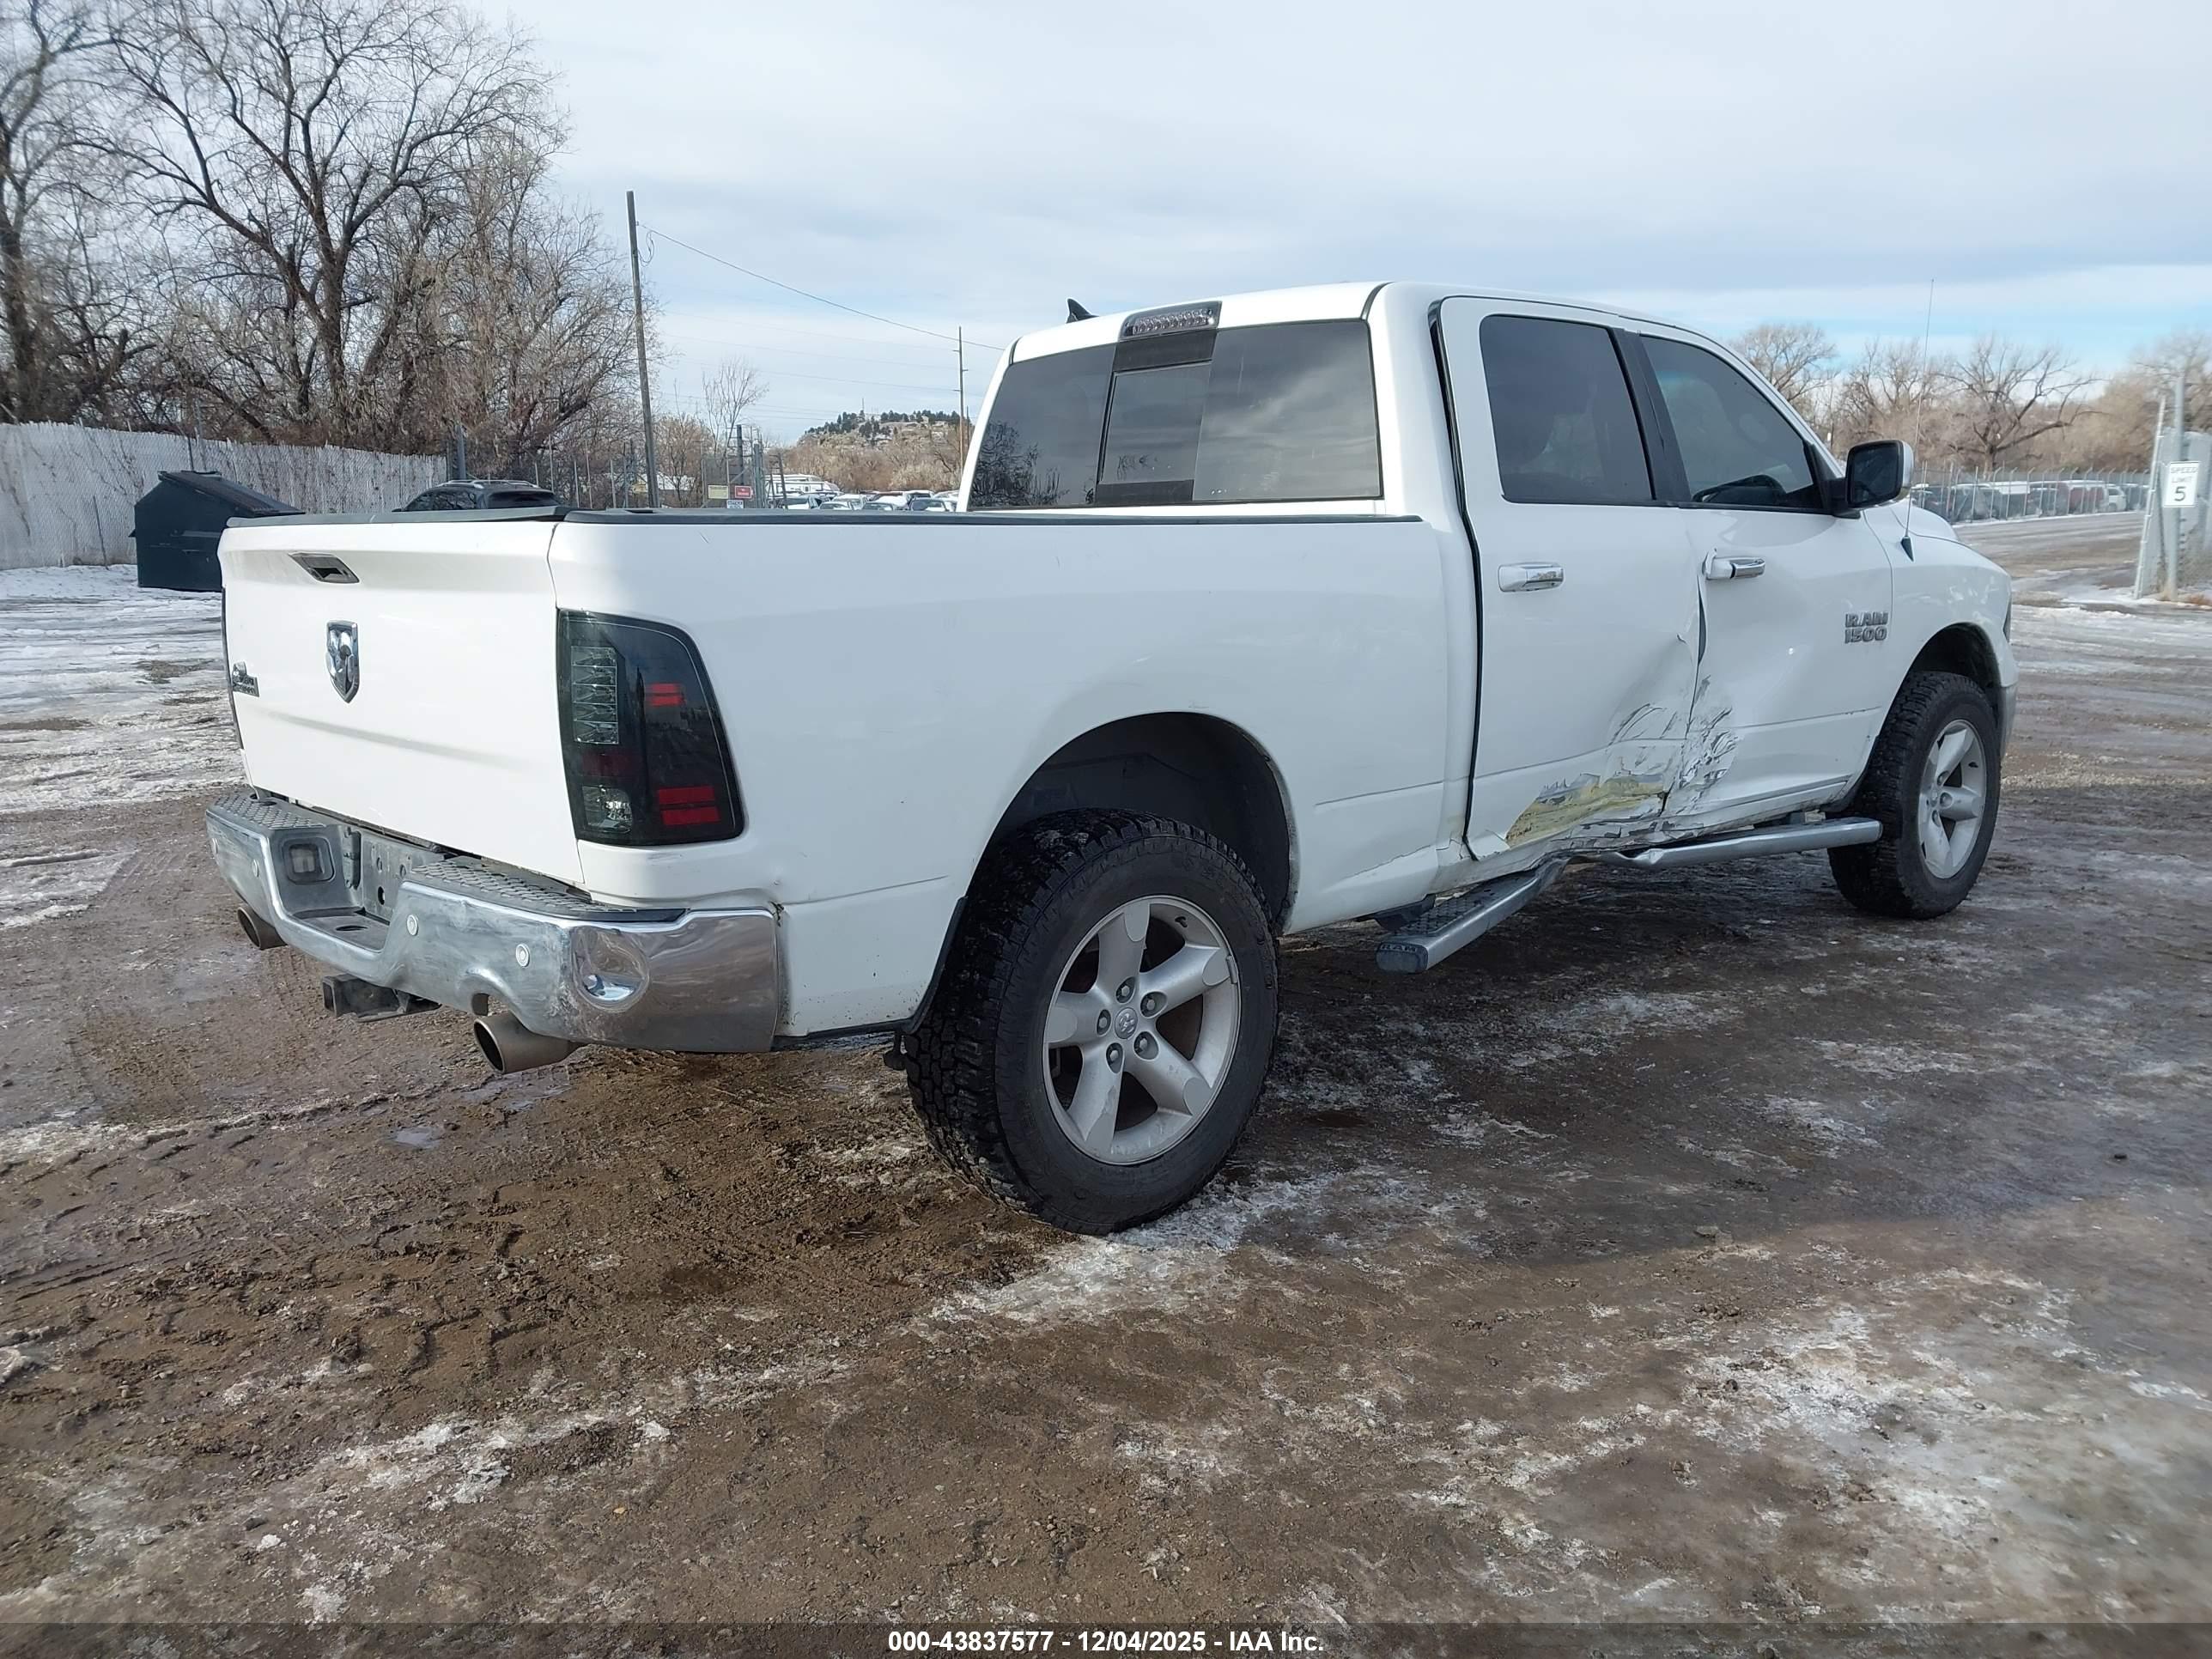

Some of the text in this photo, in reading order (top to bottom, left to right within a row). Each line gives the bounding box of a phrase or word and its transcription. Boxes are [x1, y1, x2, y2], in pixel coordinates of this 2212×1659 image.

[2174, 486, 2186, 501] 5
[1844, 611, 1889, 628] RAM
[1844, 626, 1887, 644] 1500
[1379, 944, 1417, 953] RAM
